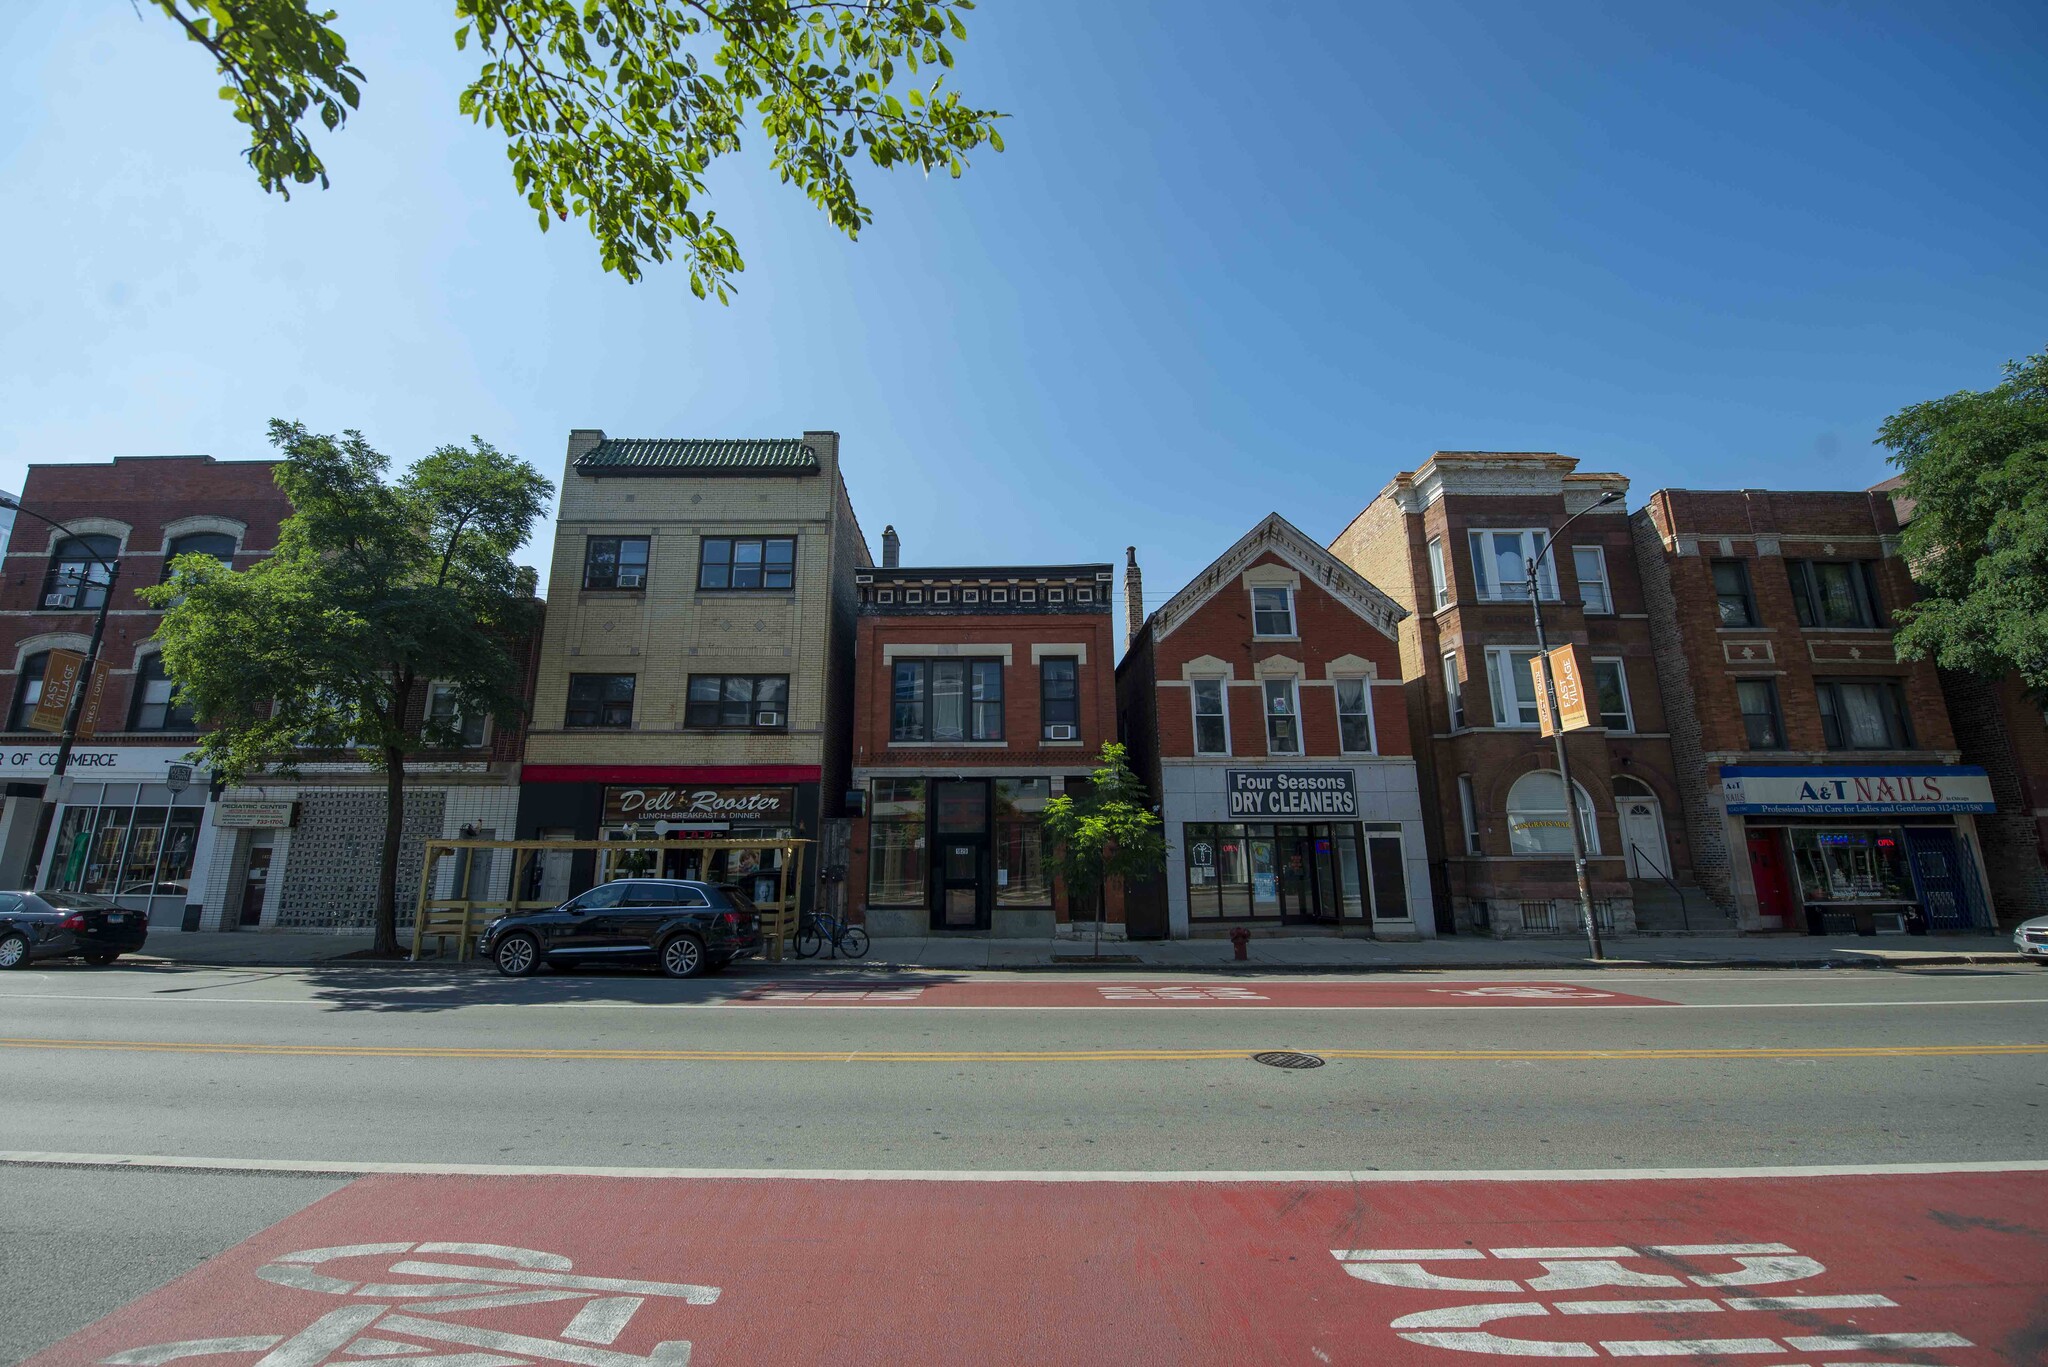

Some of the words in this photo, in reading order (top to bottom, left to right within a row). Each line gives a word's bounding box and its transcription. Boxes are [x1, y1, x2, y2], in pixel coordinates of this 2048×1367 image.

[43, 678, 60, 708] EAST
[54, 664, 76, 708] VILLAGE
[1564, 658, 1579, 706] VILLAGE
[85, 701, 98, 723] WEST
[93, 673, 105, 697] TOWN
[1560, 680, 1571, 708] EAST
[11, 753, 33, 766] OF
[38, 753, 118, 767] COMERCE
[170, 767, 191, 775] WEST
[1237, 774, 1273, 790] Four
[1277, 774, 1346, 790] Seasons
[1800, 780, 1848, 801] A&T
[1854, 776, 1943, 802] NAILS
[690, 791, 780, 812] Rooster
[1231, 792, 1263, 813] DRY
[1268, 791, 1355, 813] CLEANERS
[1761, 805, 1806, 813] Professional
[1807, 805, 1823, 813] Nail
[1824, 805, 1842, 813] Care
[1843, 804, 1855, 813] for
[1856, 804, 1880, 812] Ladies
[1880, 804, 1895, 812] and
[1896, 804, 1937, 812] Gentlemen
[1223, 844, 1239, 852] OPEN
[1877, 839, 1896, 847] OPEN
[1329, 1243, 1976, 1367] BU
